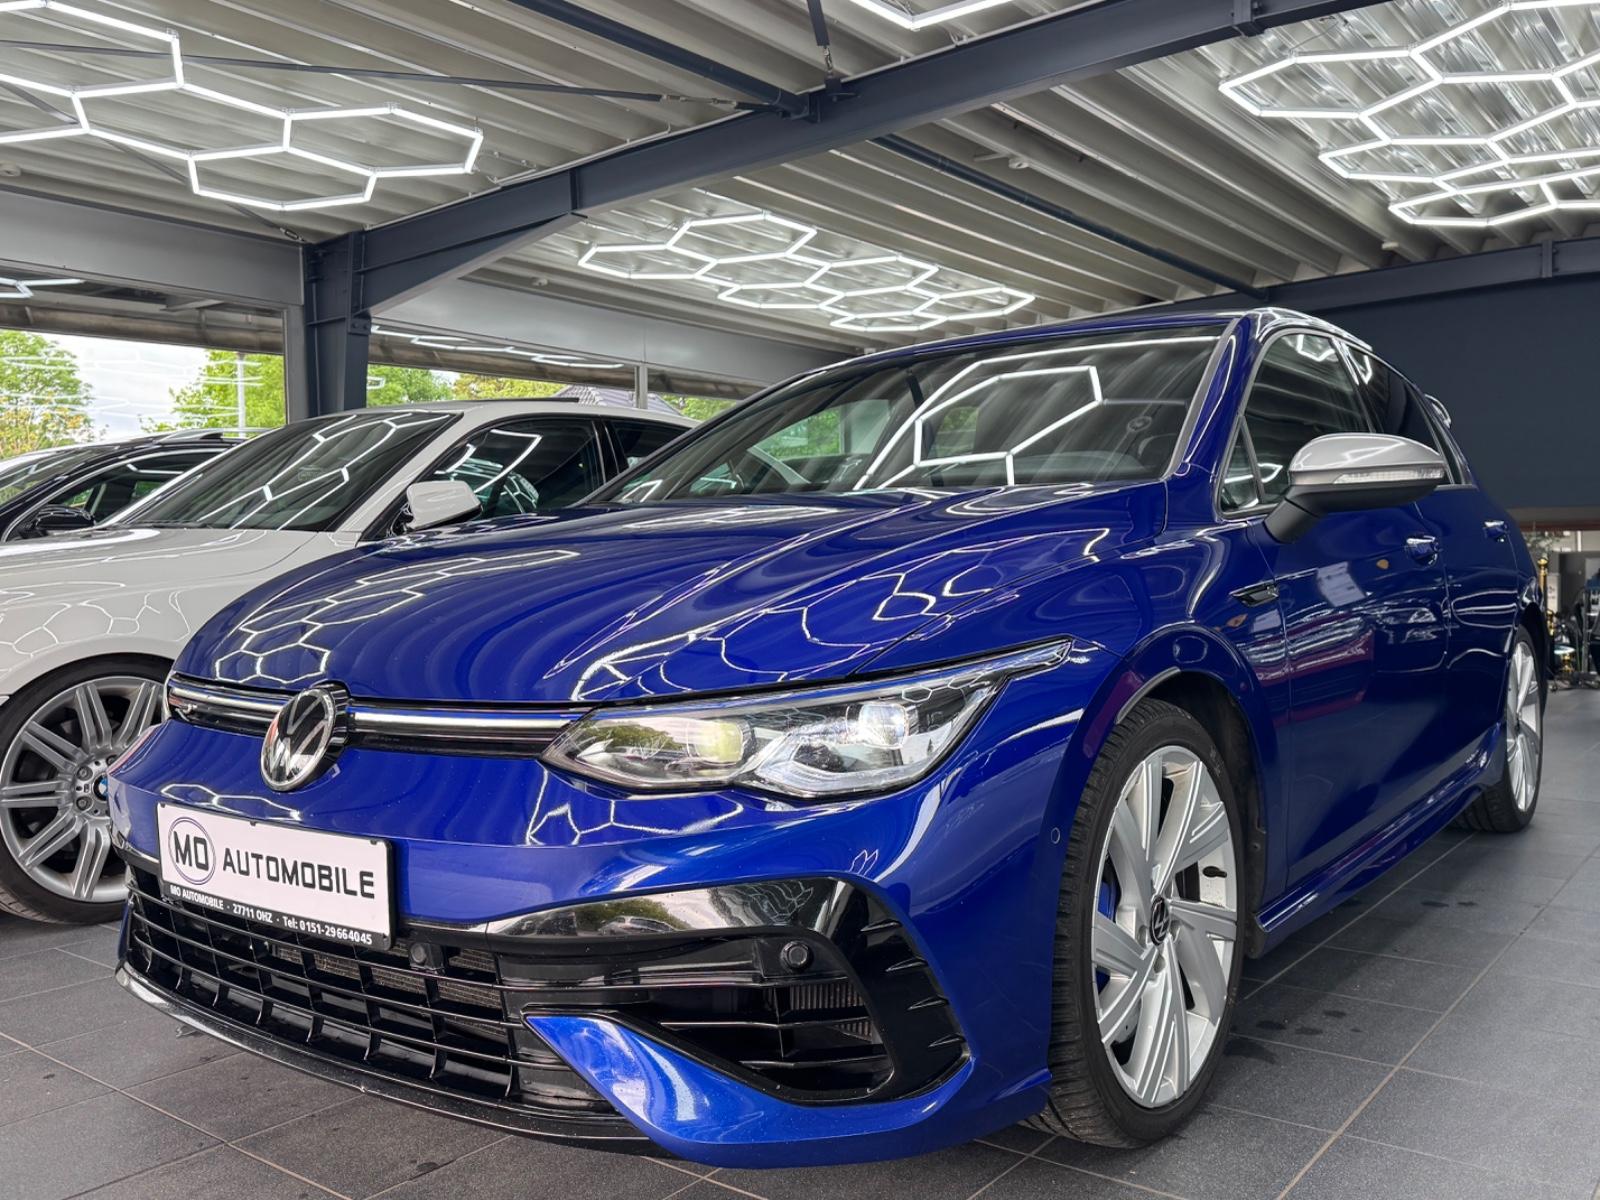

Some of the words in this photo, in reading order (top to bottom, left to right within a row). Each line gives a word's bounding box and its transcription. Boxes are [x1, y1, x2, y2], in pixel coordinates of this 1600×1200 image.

[173, 831, 209, 871] MO
[222, 848, 375, 899] AUTOMOBILE
[170, 884, 181, 897] MO
[182, 889, 224, 910] AUTOMOBILE
[233, 903, 255, 919] 27711
[256, 910, 273, 923] OHZ
[282, 916, 298, 930] Tel:
